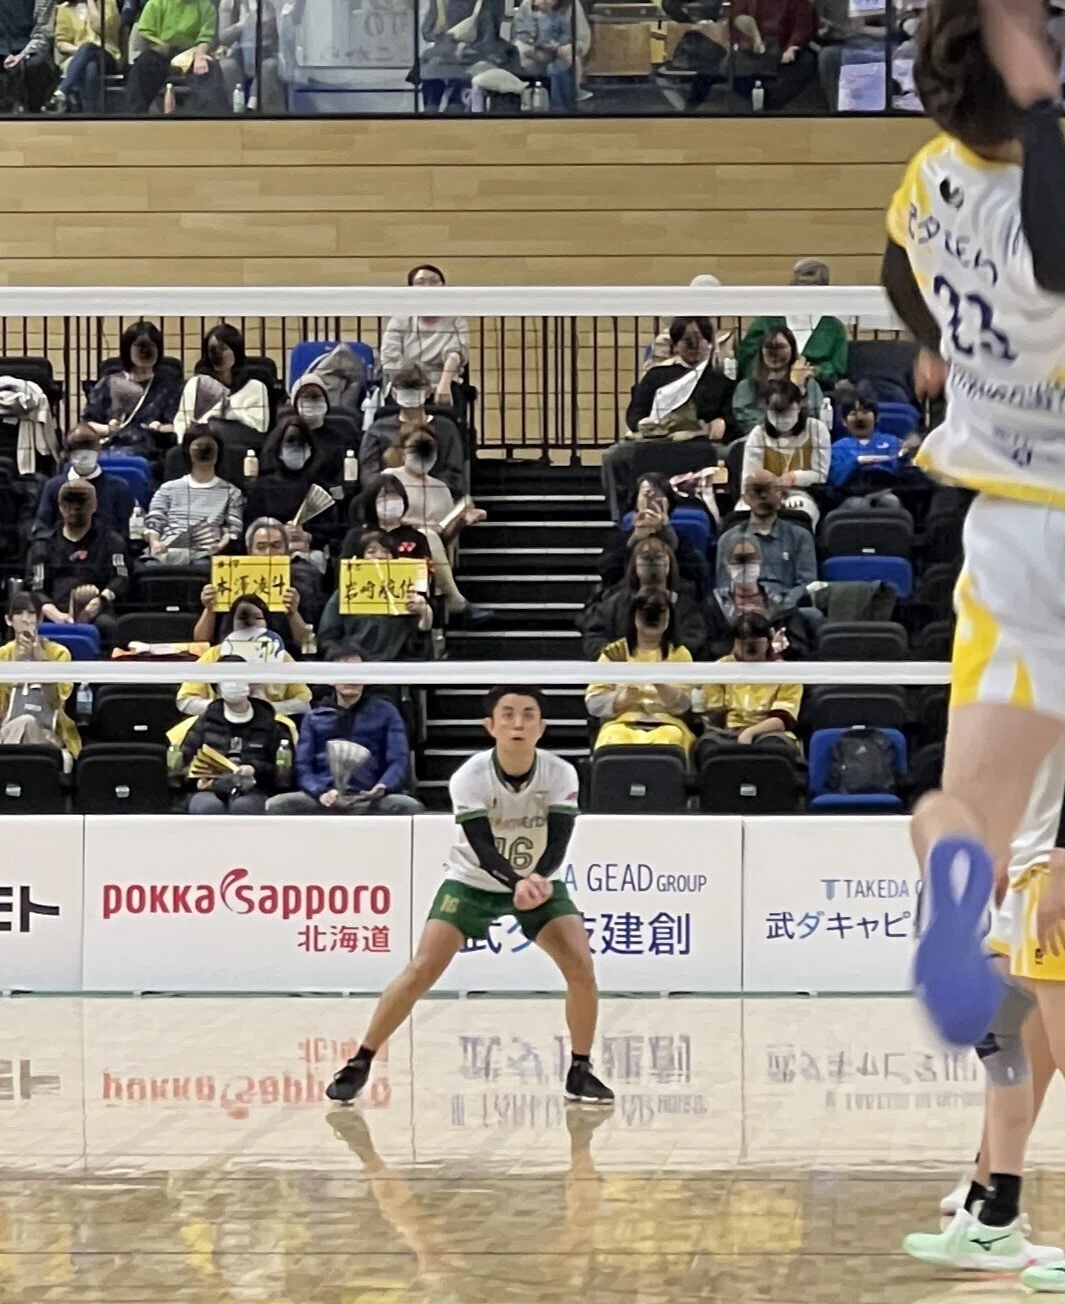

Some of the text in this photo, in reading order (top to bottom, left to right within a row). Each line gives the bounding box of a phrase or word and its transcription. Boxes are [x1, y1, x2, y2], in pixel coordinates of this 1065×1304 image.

[587, 863, 654, 892] GEAD
[656, 874, 708, 893] GROUP
[844, 879, 910, 899] TAKEDA
[297, 924, 391, 953] 北海道
[765, 910, 921, 940] 武ダキャピ
